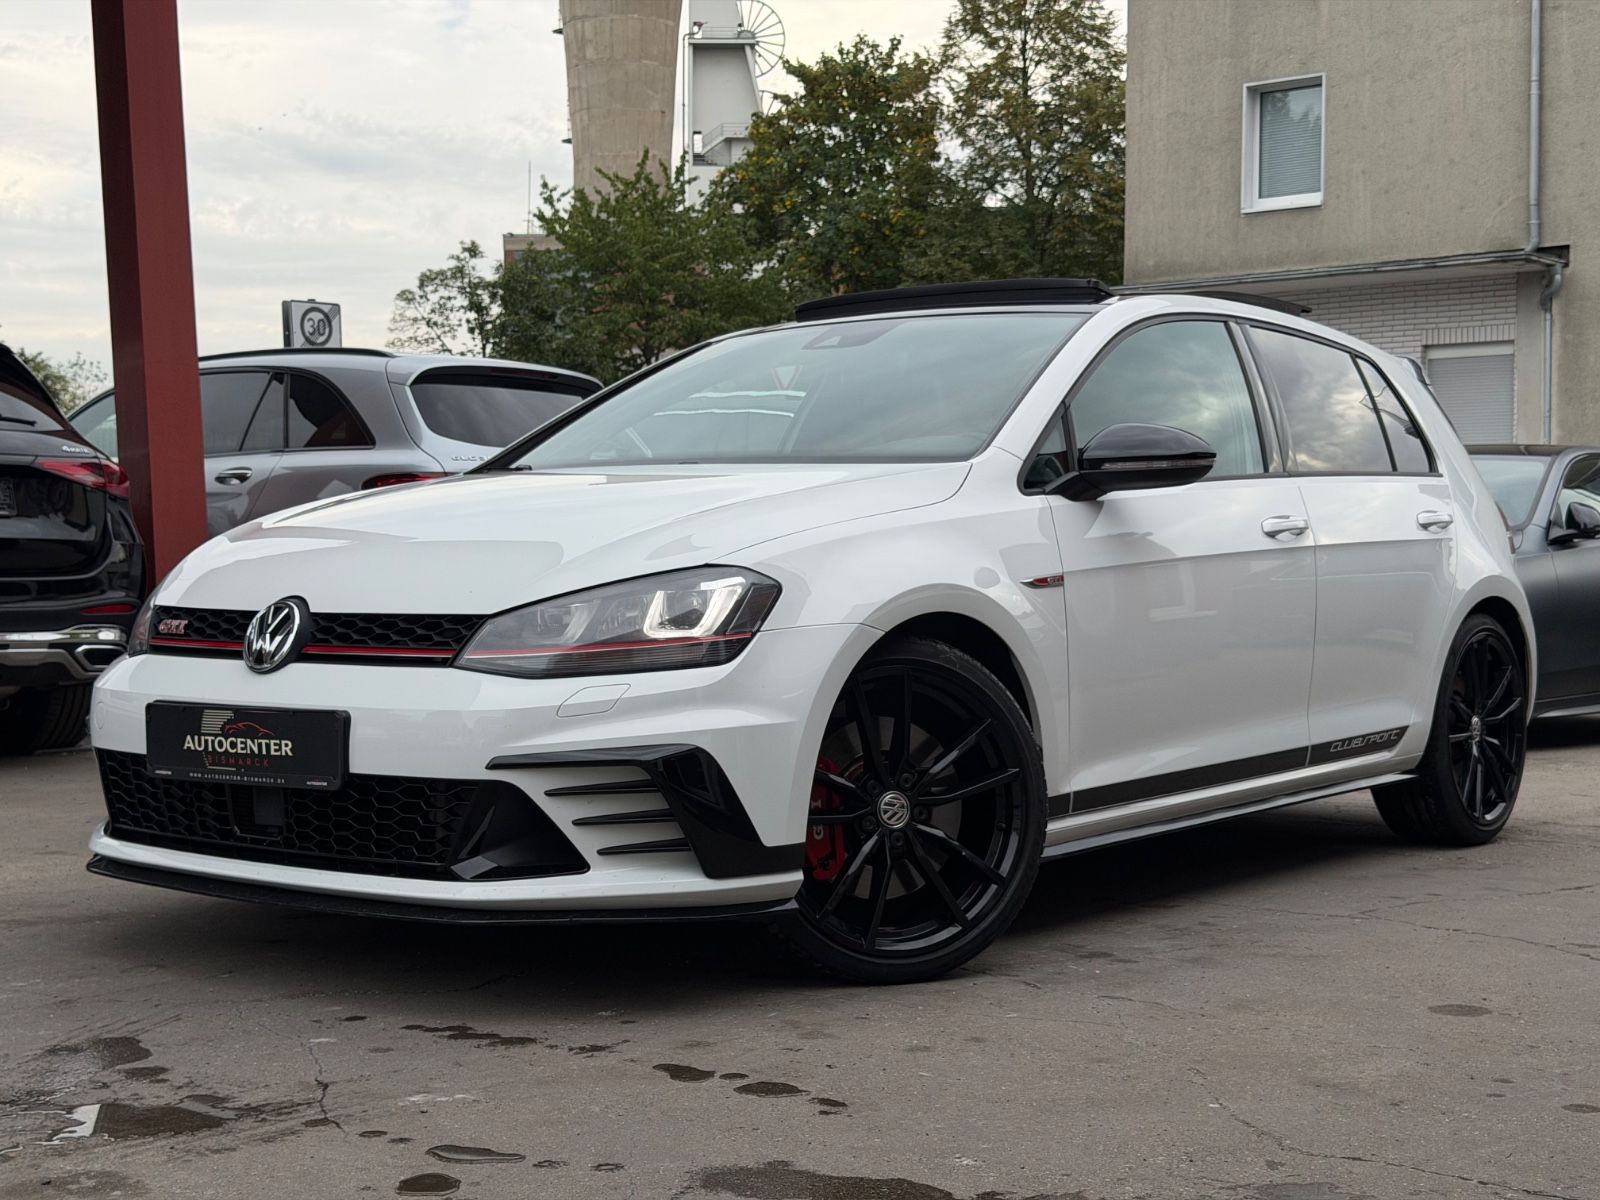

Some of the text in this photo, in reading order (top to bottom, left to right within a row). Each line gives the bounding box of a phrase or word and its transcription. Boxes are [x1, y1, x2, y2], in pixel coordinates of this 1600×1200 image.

[307, 317, 326, 336] 30
[158, 619, 188, 634] GTI
[183, 734, 293, 756] AUTOCENTER
[207, 754, 270, 768] BISMARCK
